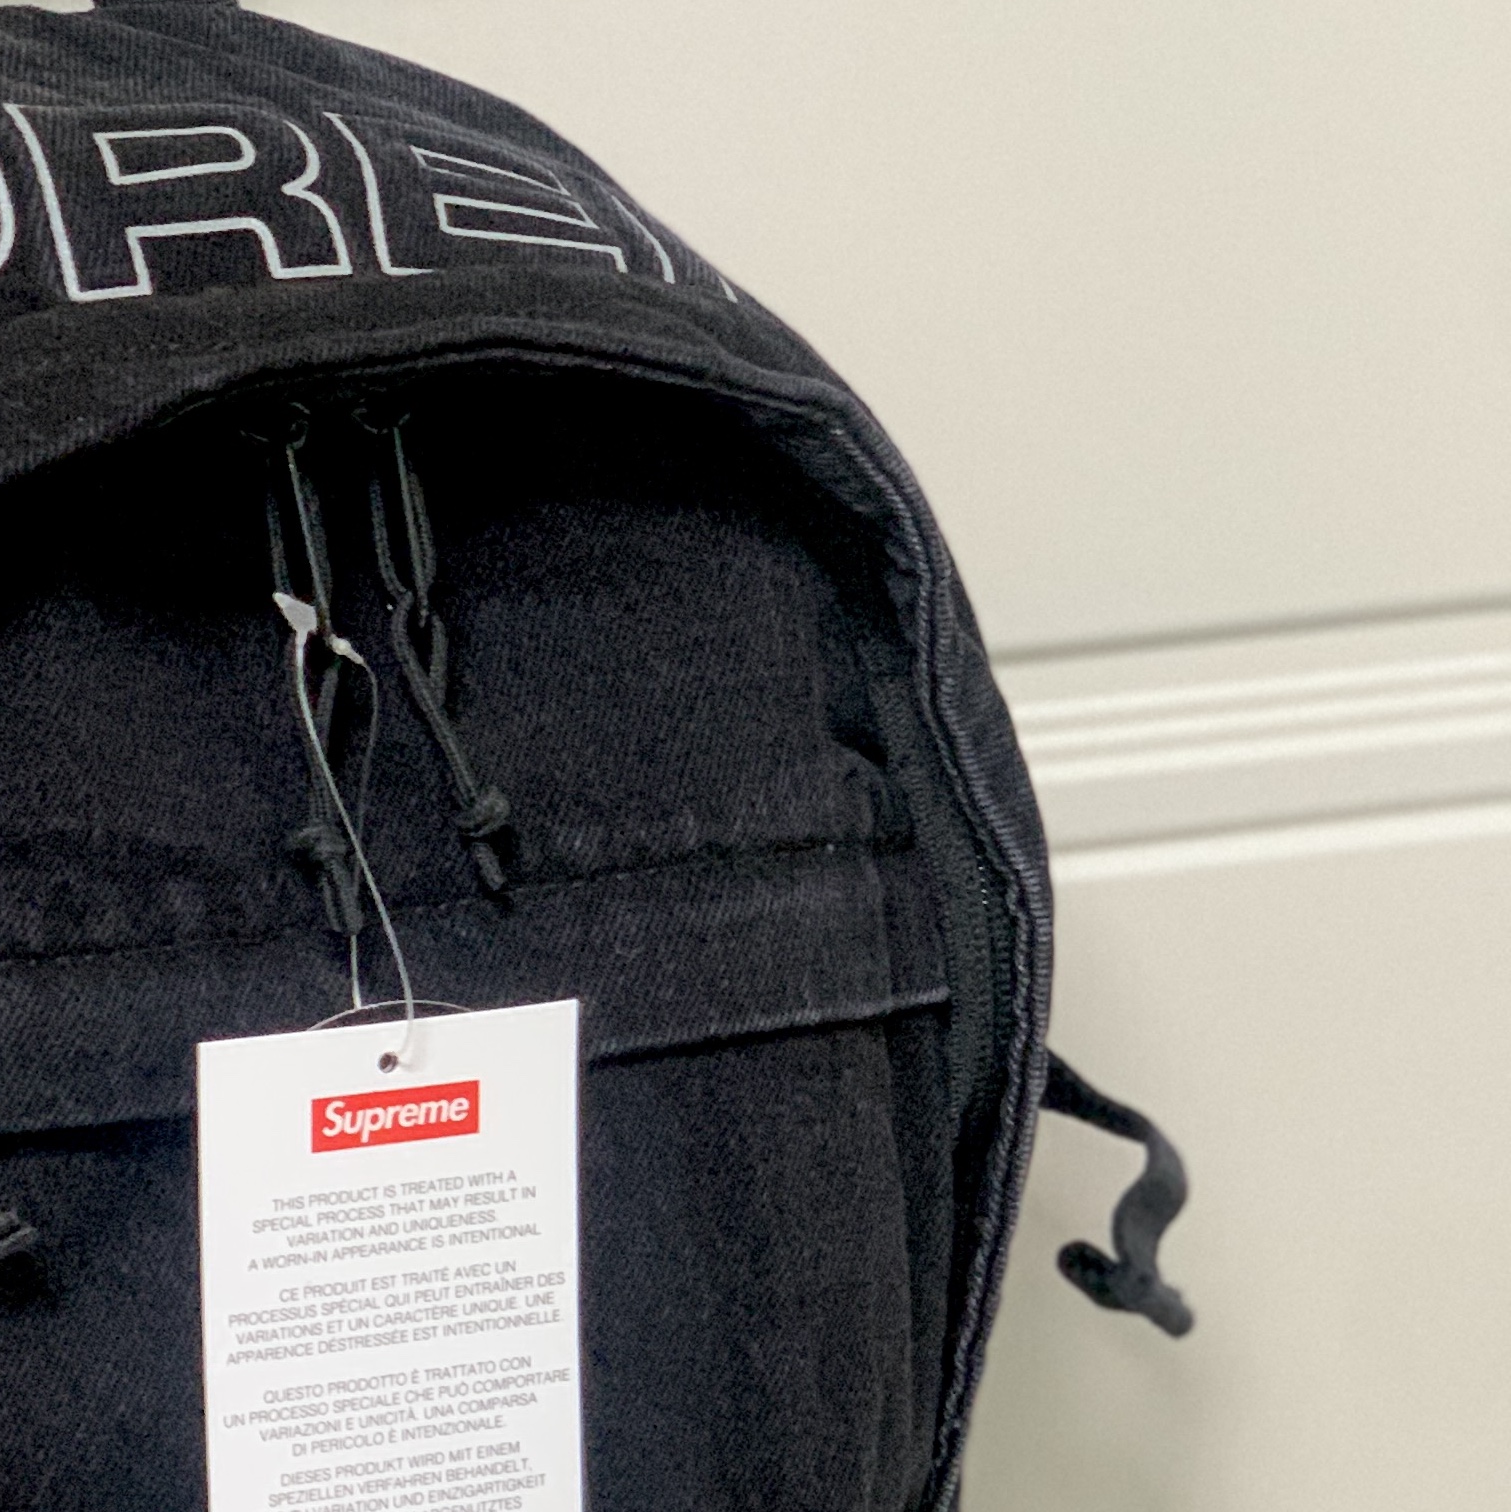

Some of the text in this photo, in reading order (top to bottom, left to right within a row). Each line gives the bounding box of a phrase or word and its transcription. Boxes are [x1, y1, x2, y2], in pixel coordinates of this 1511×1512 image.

[322, 1096, 469, 1143] Supreme
[252, 1186, 536, 1233] SPECIAL PROCESS THAT MAY RESULT IN
[272, 1170, 516, 1211] THIS PRODUCT IS TREATED WITH A
[248, 1259, 258, 1270] A
[262, 1250, 327, 1268] WORN-IN
[332, 1237, 426, 1259] APPEARANCE
[431, 1234, 444, 1247] IS
[286, 1227, 364, 1246] VARIATION
[368, 1221, 399, 1236] AND
[228, 1304, 317, 1326] PROCESSUS
[320, 1297, 380, 1315] SPÉCIAL
[384, 1293, 410, 1307] QUI
[414, 1286, 450, 1302] PEUT
[537, 1273, 565, 1287] DES
[279, 1260, 516, 1302] CE PRODUIT EST TRAITÉ AVEC UN
[236, 1322, 322, 1343] VARIATIONS
[326, 1319, 343, 1333] ET
[347, 1317, 369, 1331] UN
[525, 1291, 554, 1307] UNE
[226, 1342, 313, 1364] APPARENCE
[412, 1325, 438, 1340] EST
[223, 1414, 245, 1428] UN
[248, 1402, 328, 1423] PROCESSO
[332, 1392, 400, 1412] SPECIALE
[404, 1387, 434, 1403] CHE
[472, 1368, 569, 1393] COMPORTARE
[263, 1356, 531, 1403] QUESTO PRODOTTO È TRATTATO CON
[259, 1420, 341, 1440] VARIAZIONI
[345, 1417, 354, 1430] E
[423, 1404, 454, 1419] UNA
[457, 1393, 537, 1414] COMPARSA
[280, 1441, 520, 1486] DIESES PRODUKT WIRD MIT EINEM
[292, 1443, 306, 1456] DI
[310, 1432, 384, 1452] PERICOLO
[388, 1429, 396, 1443] È
[268, 1484, 354, 1506] SPEZIELLEN
[357, 1471, 442, 1493] VERFAHREN
[392, 1492, 424, 1508] UND
[427, 1474, 545, 1502] EINZIGARTIGKEIT
